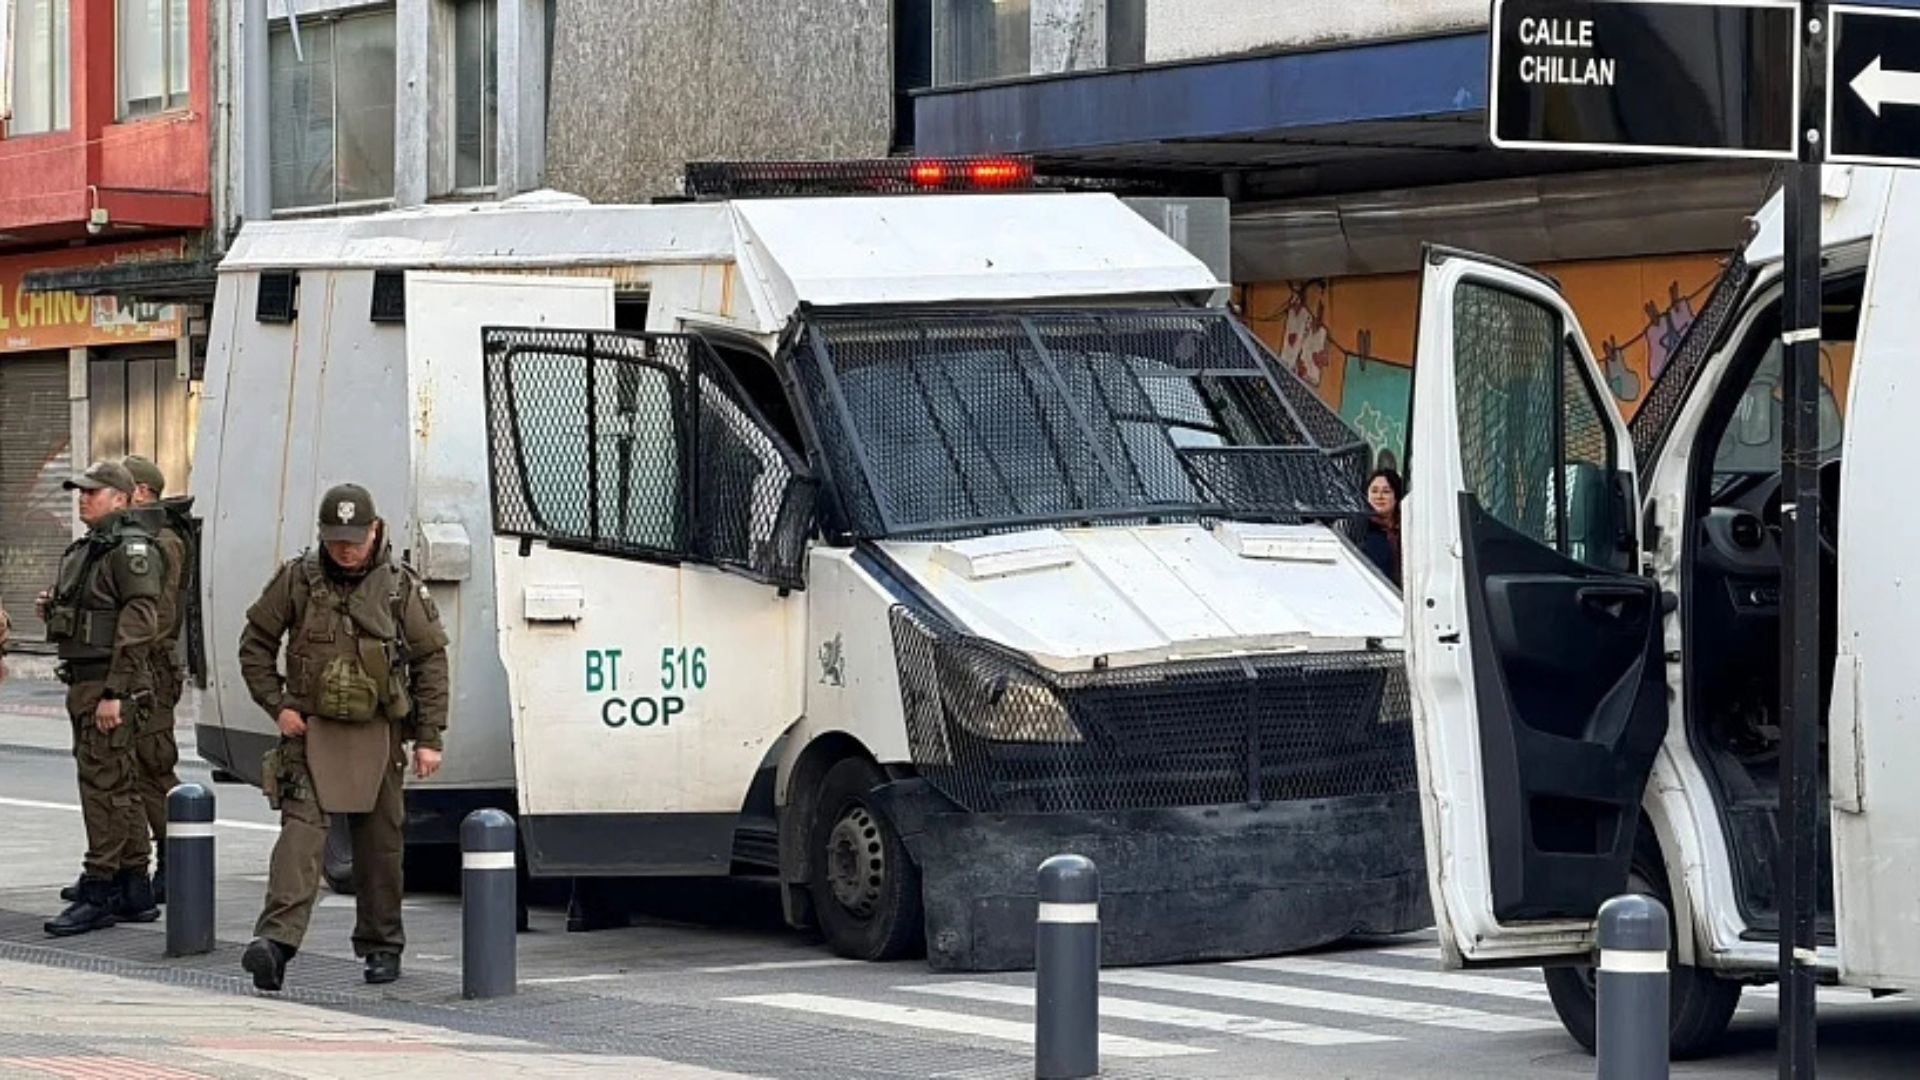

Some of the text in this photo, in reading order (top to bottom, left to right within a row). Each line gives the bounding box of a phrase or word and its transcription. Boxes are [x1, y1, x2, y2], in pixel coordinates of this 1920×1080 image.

[1519, 16, 1593, 47] CALLE
[1519, 54, 1616, 86] CHILLAN
[15, 278, 91, 328] CHINO
[585, 646, 707, 692] BT 516
[602, 696, 685, 728] COP
